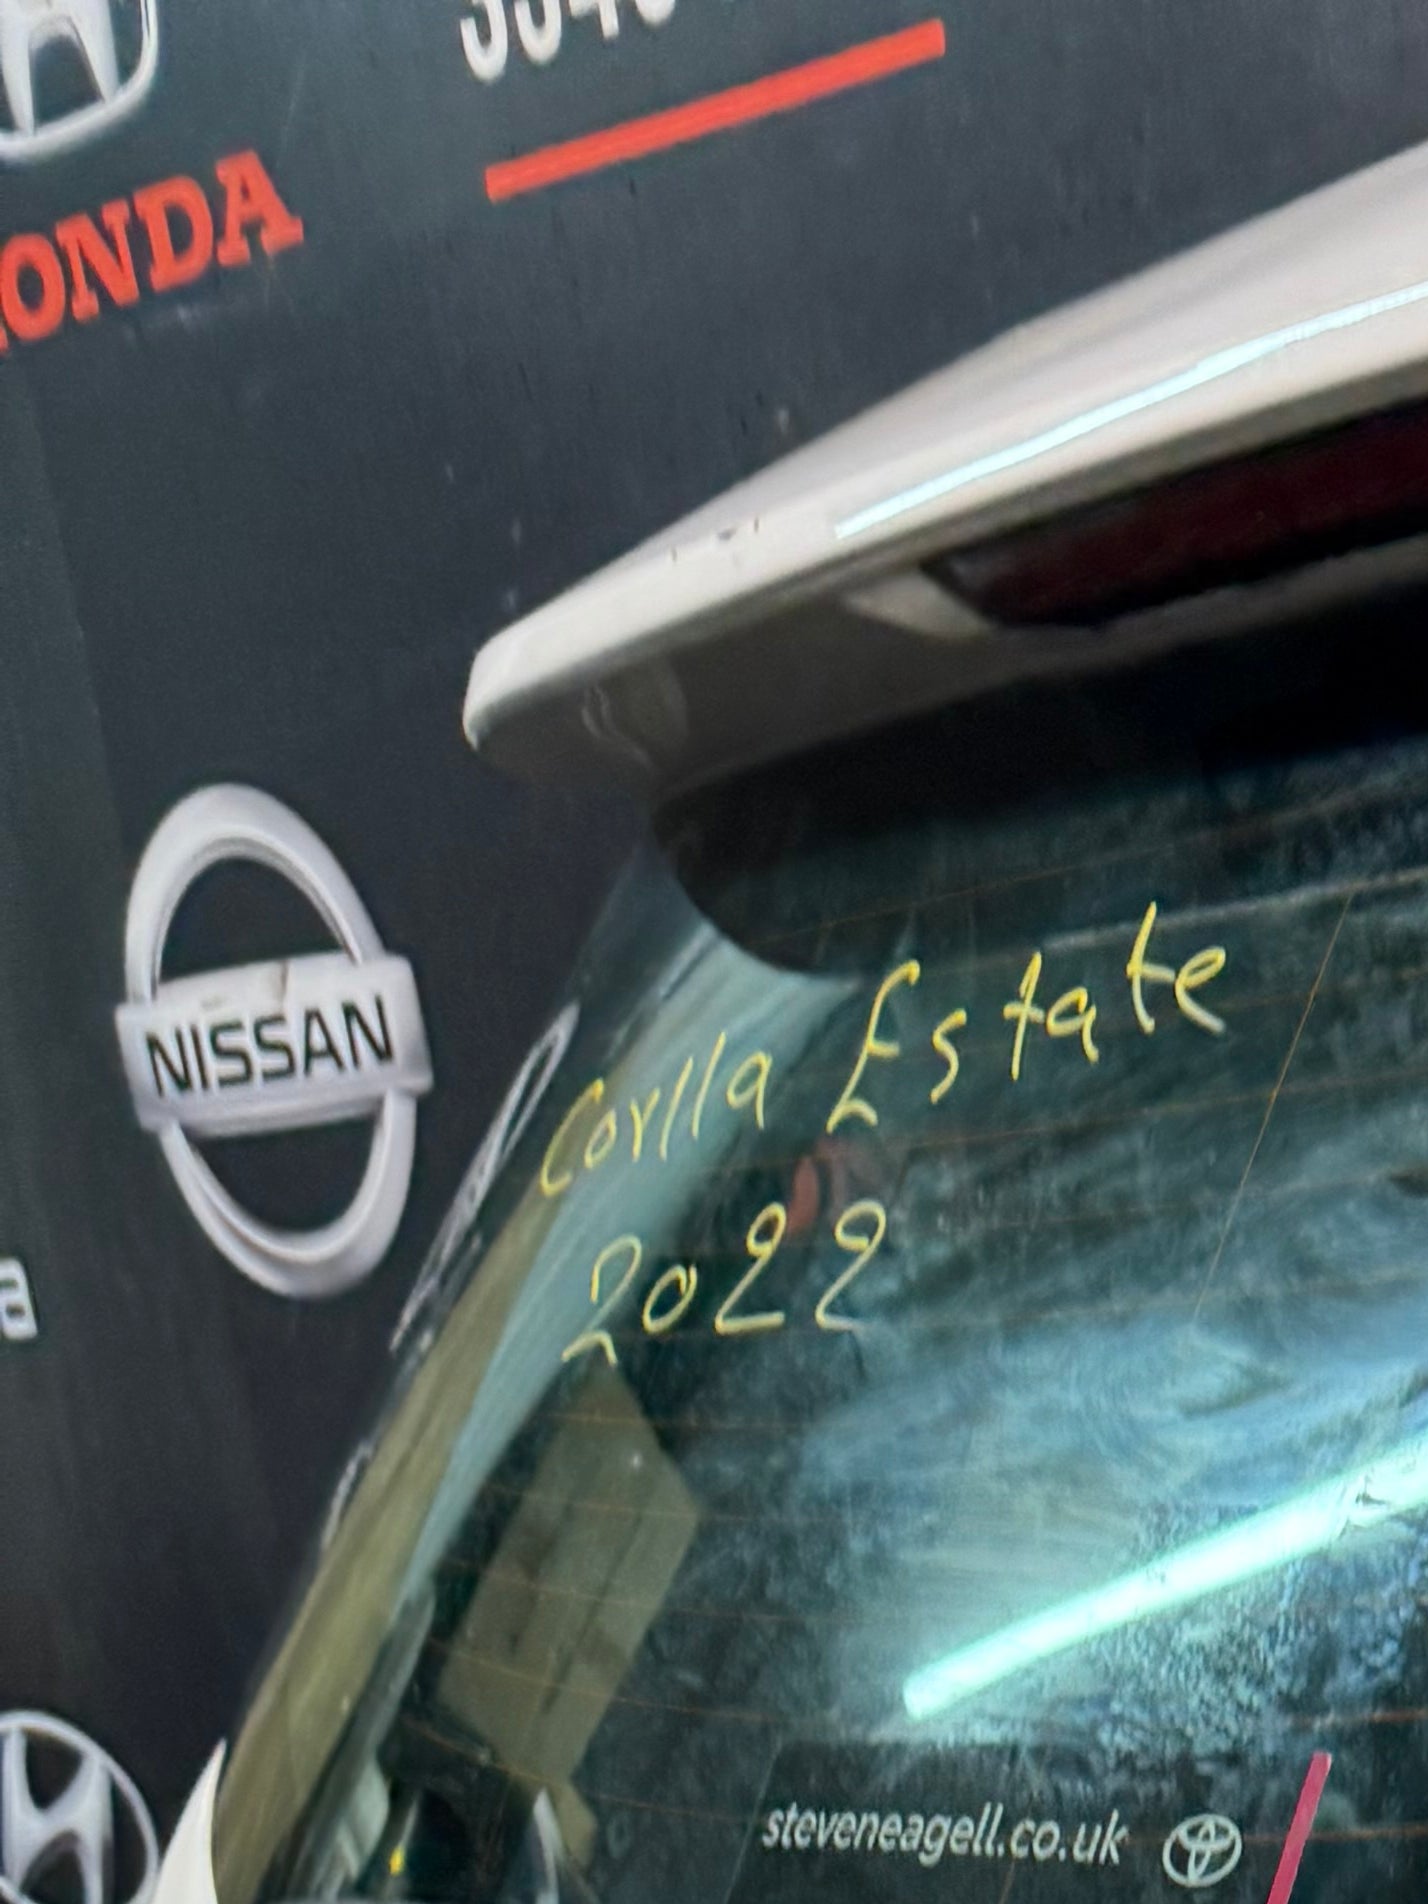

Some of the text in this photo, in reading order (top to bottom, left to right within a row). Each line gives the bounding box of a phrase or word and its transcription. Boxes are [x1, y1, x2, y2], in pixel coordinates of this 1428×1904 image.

[0, 149, 304, 358] ONDA
[145, 993, 395, 1097] NISSAN
[826, 901, 1226, 1134] Estate
[562, 1200, 887, 1366] 2022
[761, 1801, 1130, 1869] steveneagell.co.uk
